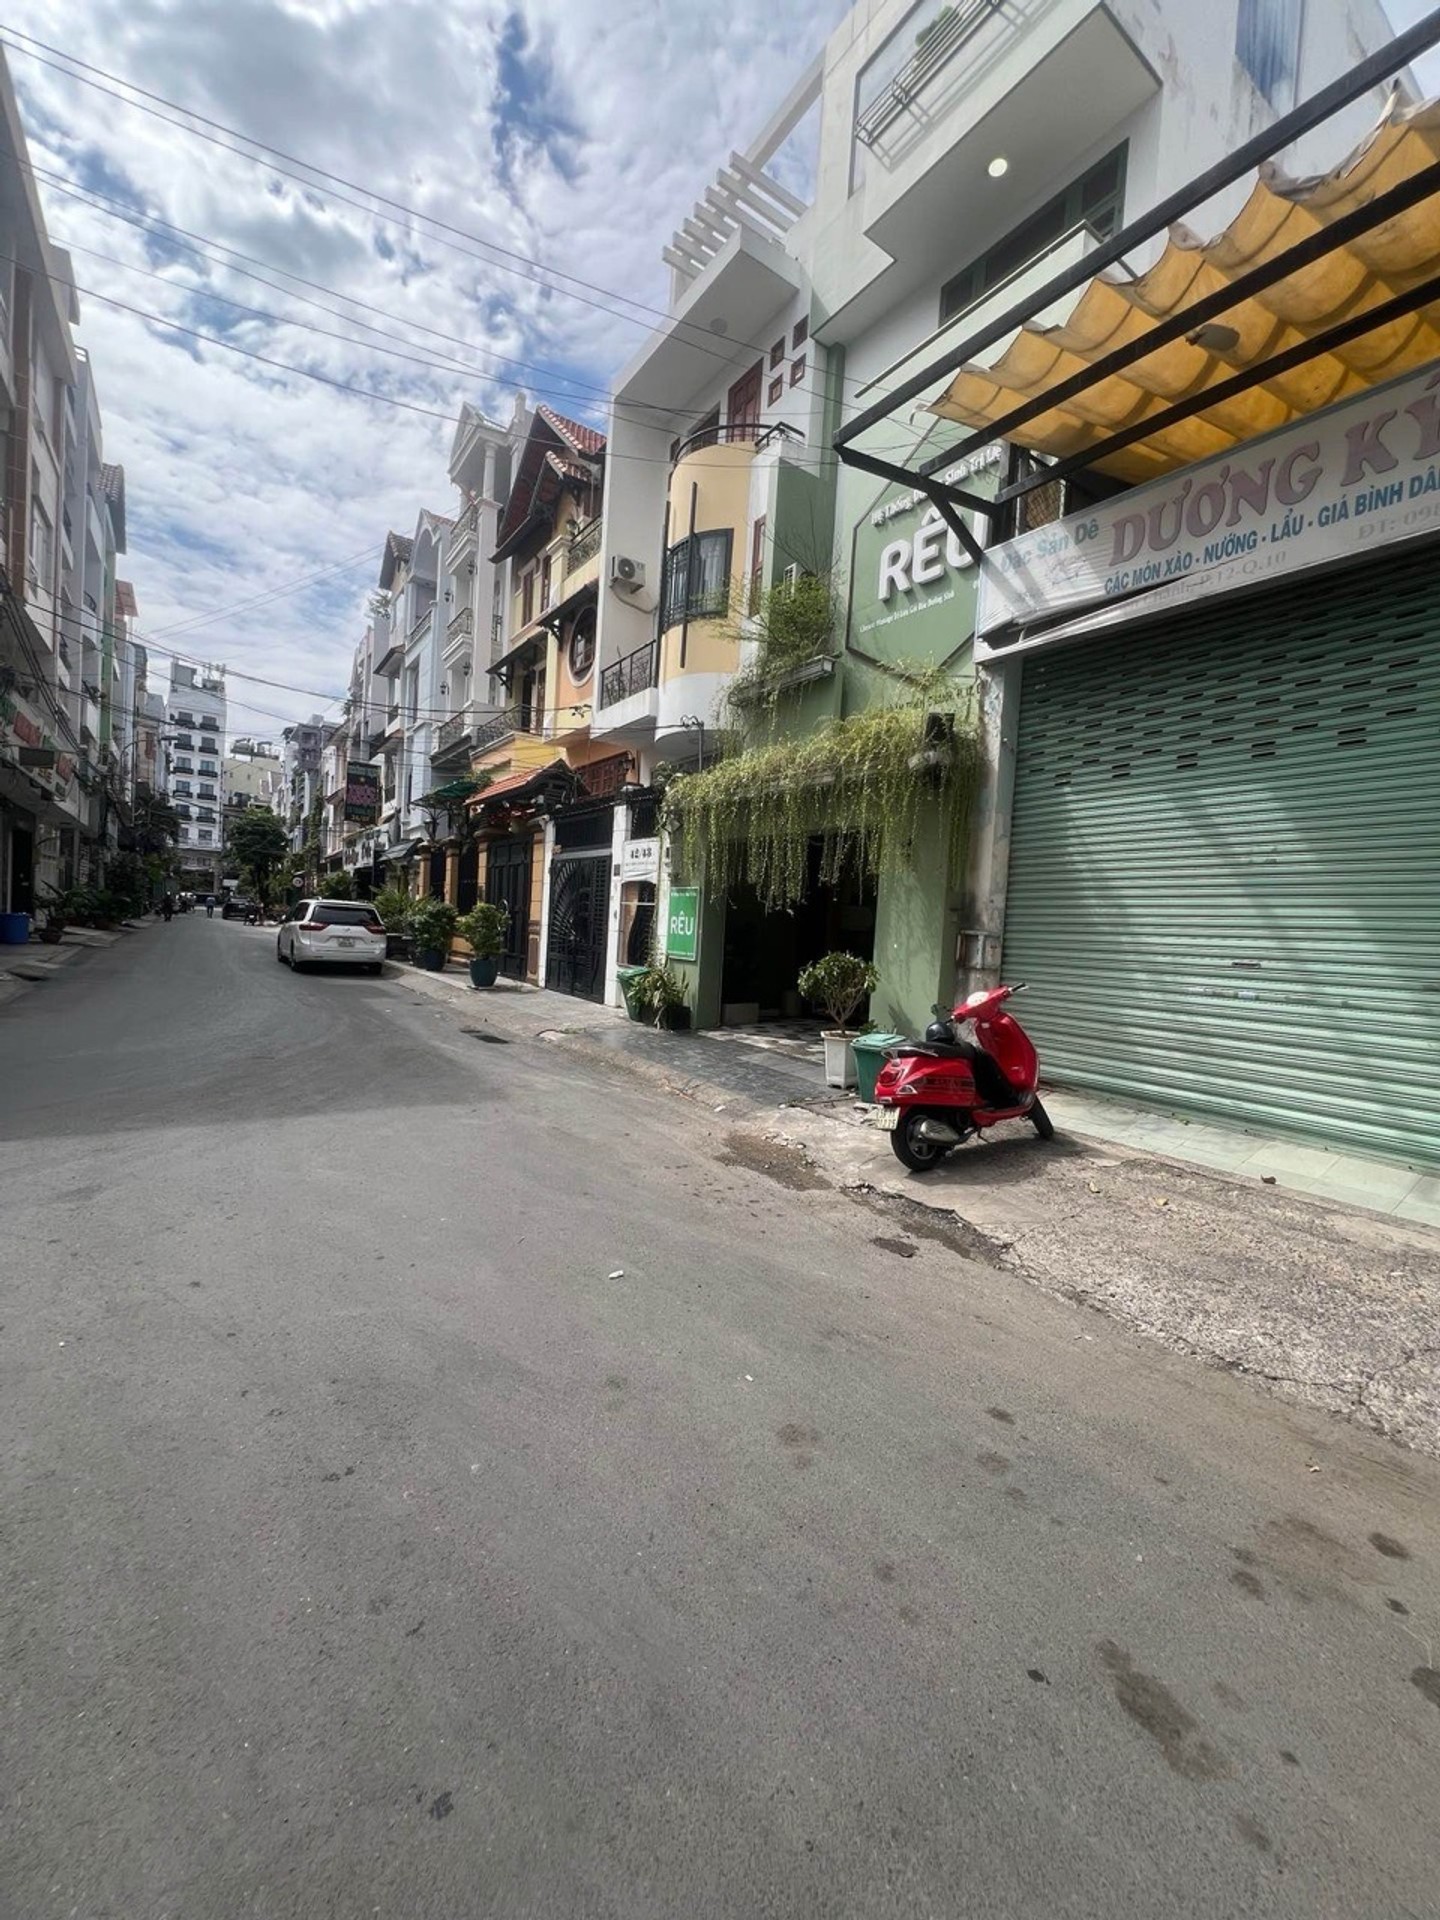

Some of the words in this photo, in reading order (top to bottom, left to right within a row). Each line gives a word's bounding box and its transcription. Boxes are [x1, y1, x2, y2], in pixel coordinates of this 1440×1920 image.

[1075, 518, 1099, 545] Dê
[1105, 571, 1129, 595] CÁC
[1132, 559, 1161, 587] MÓN
[1164, 550, 1192, 576] XÀO
[1203, 531, 1257, 565] NƯỚNG
[1271, 508, 1304, 542] LẨU
[1318, 494, 1349, 528] GIÁ
[1355, 481, 1403, 516] BÌNH
[1409, 465, 1440, 499] DÂ
[1109, 440, 1323, 566] DƯƠNG
[878, 506, 988, 601] RÊU
[670, 910, 694, 935] RÊU
